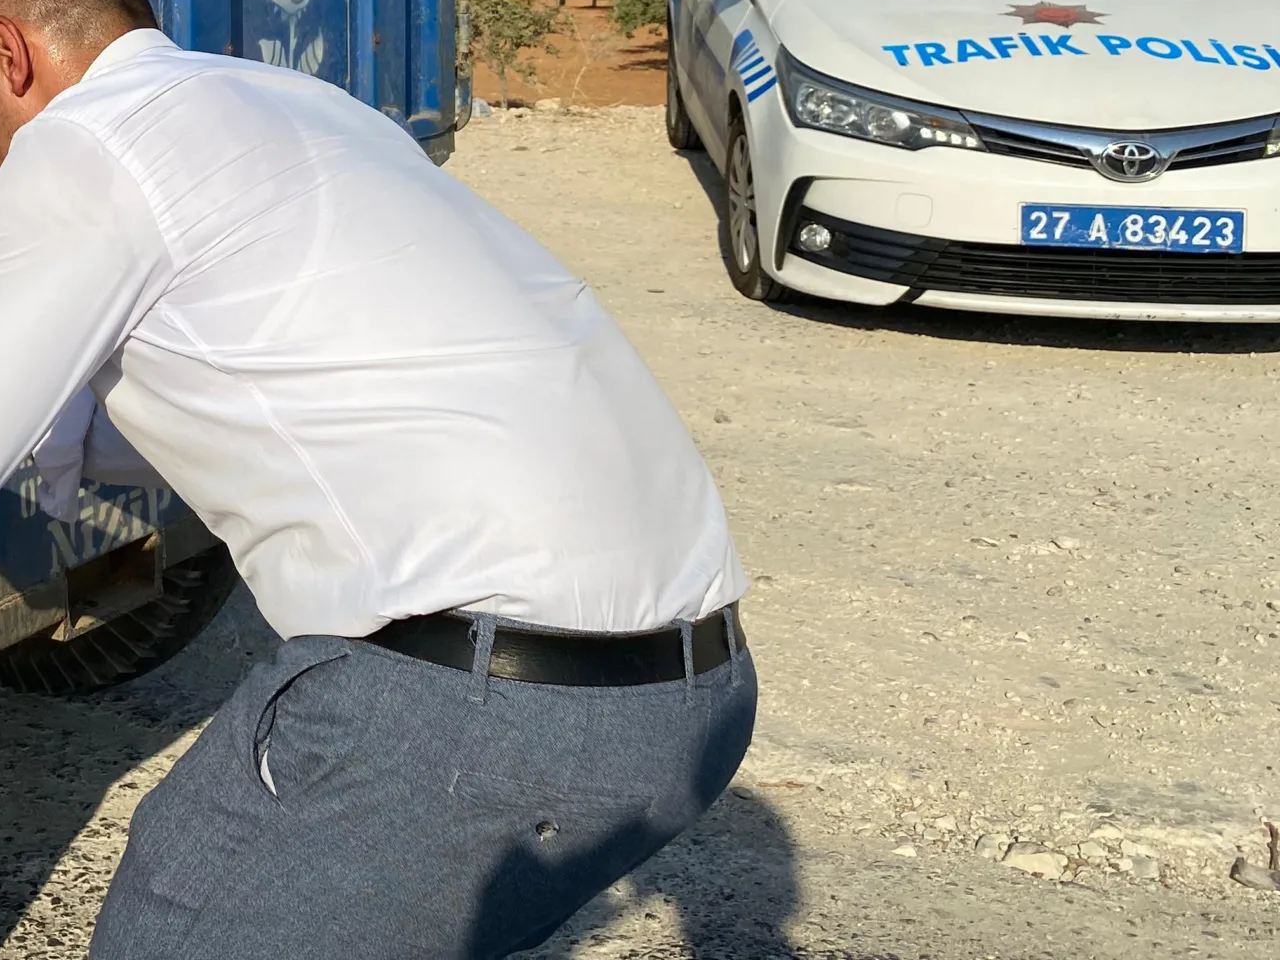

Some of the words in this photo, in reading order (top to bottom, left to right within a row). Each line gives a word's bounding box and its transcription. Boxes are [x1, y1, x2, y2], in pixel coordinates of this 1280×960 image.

[882, 32, 1090, 67] TRAFİK
[1029, 211, 1070, 240] 27
[1088, 213, 1108, 242] A
[1125, 214, 1235, 246] 83423
